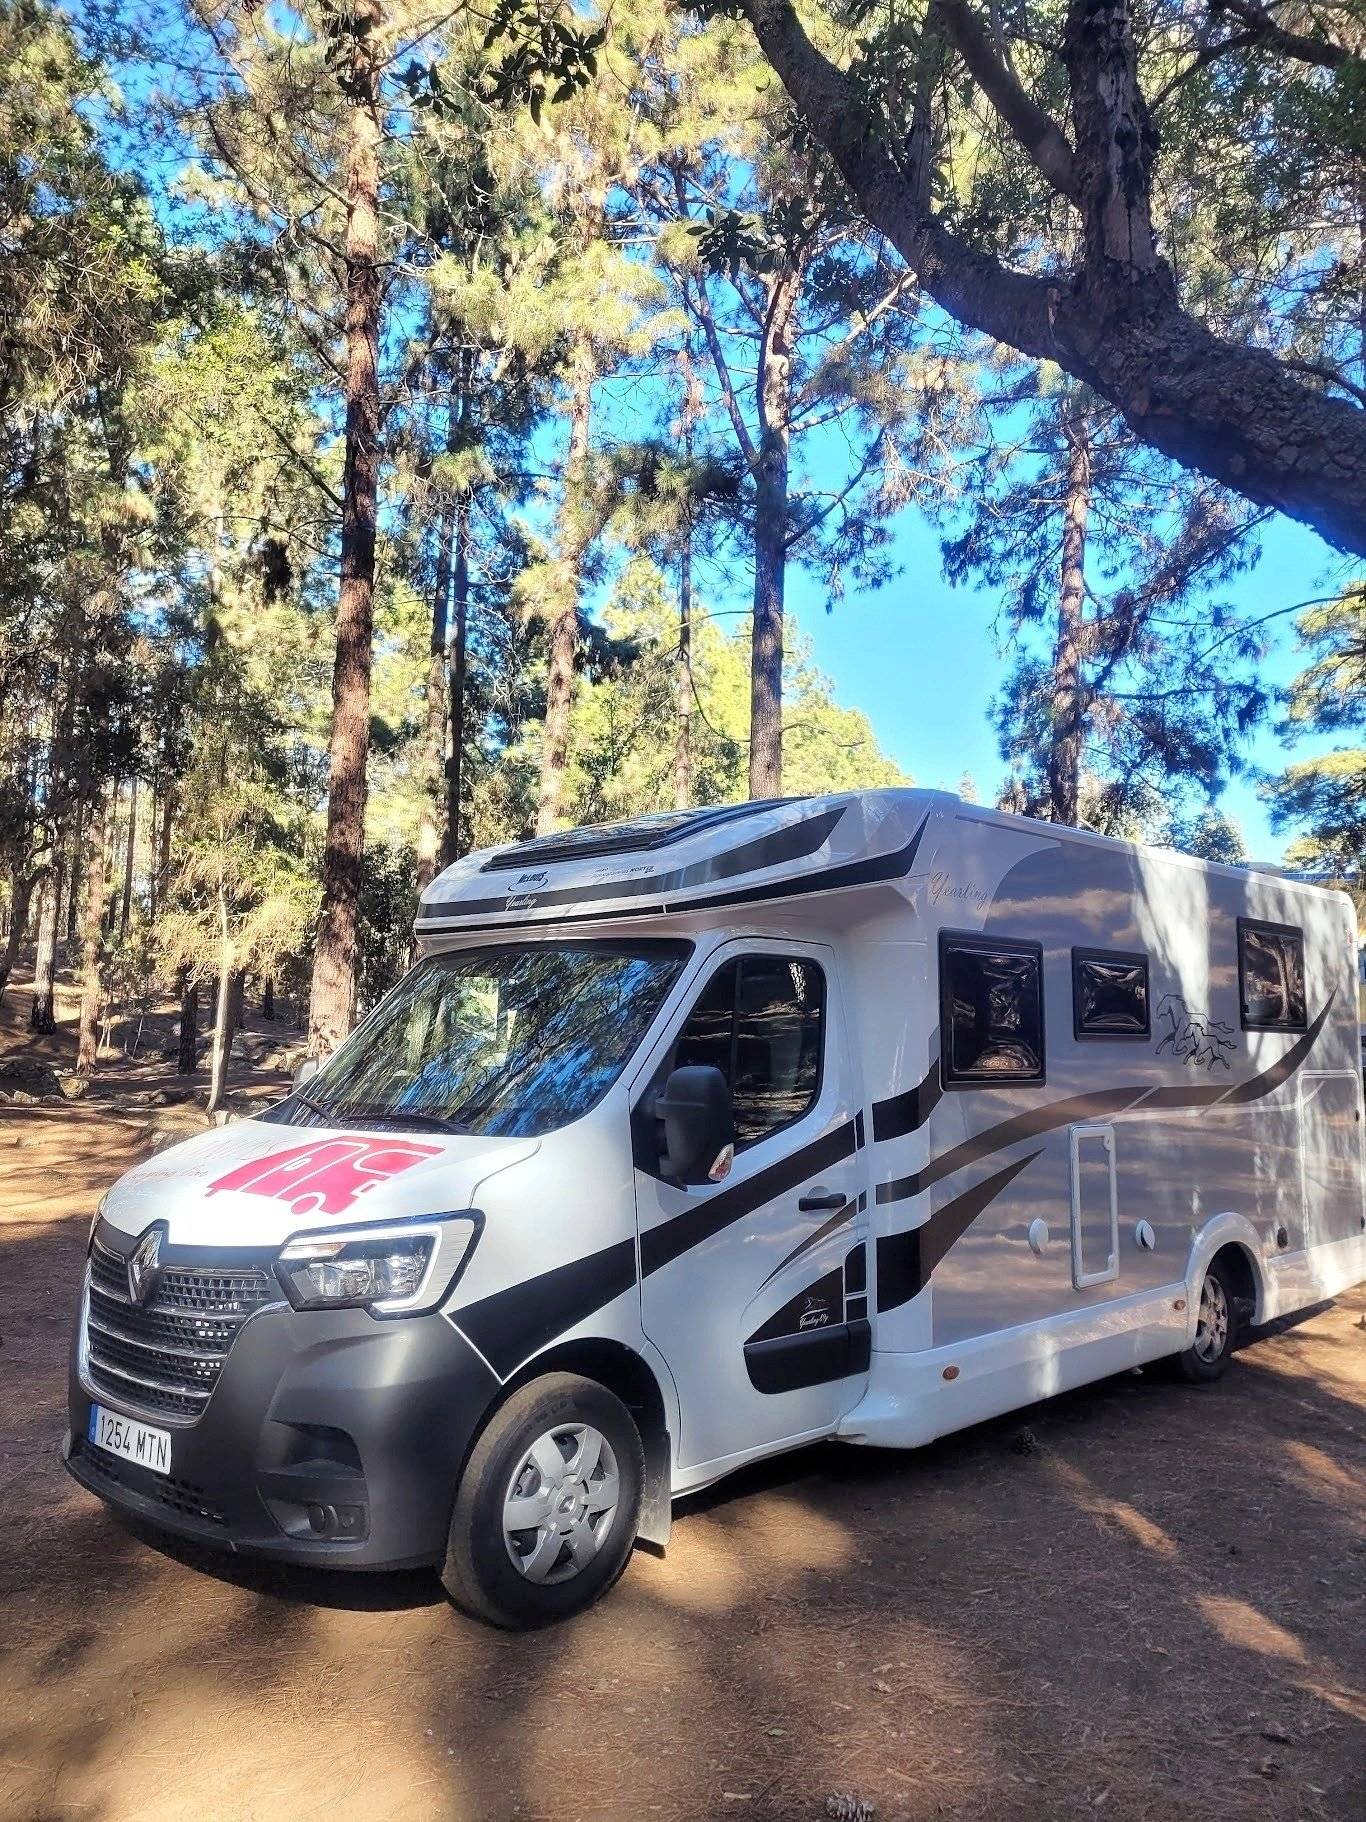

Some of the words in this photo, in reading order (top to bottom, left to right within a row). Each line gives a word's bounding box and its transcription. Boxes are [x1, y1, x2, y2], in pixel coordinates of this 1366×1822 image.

[505, 895, 537, 911] Yearling
[930, 872, 988, 910] Yearling
[101, 1415, 131, 1454] 1254
[135, 1429, 168, 1467] MTN
